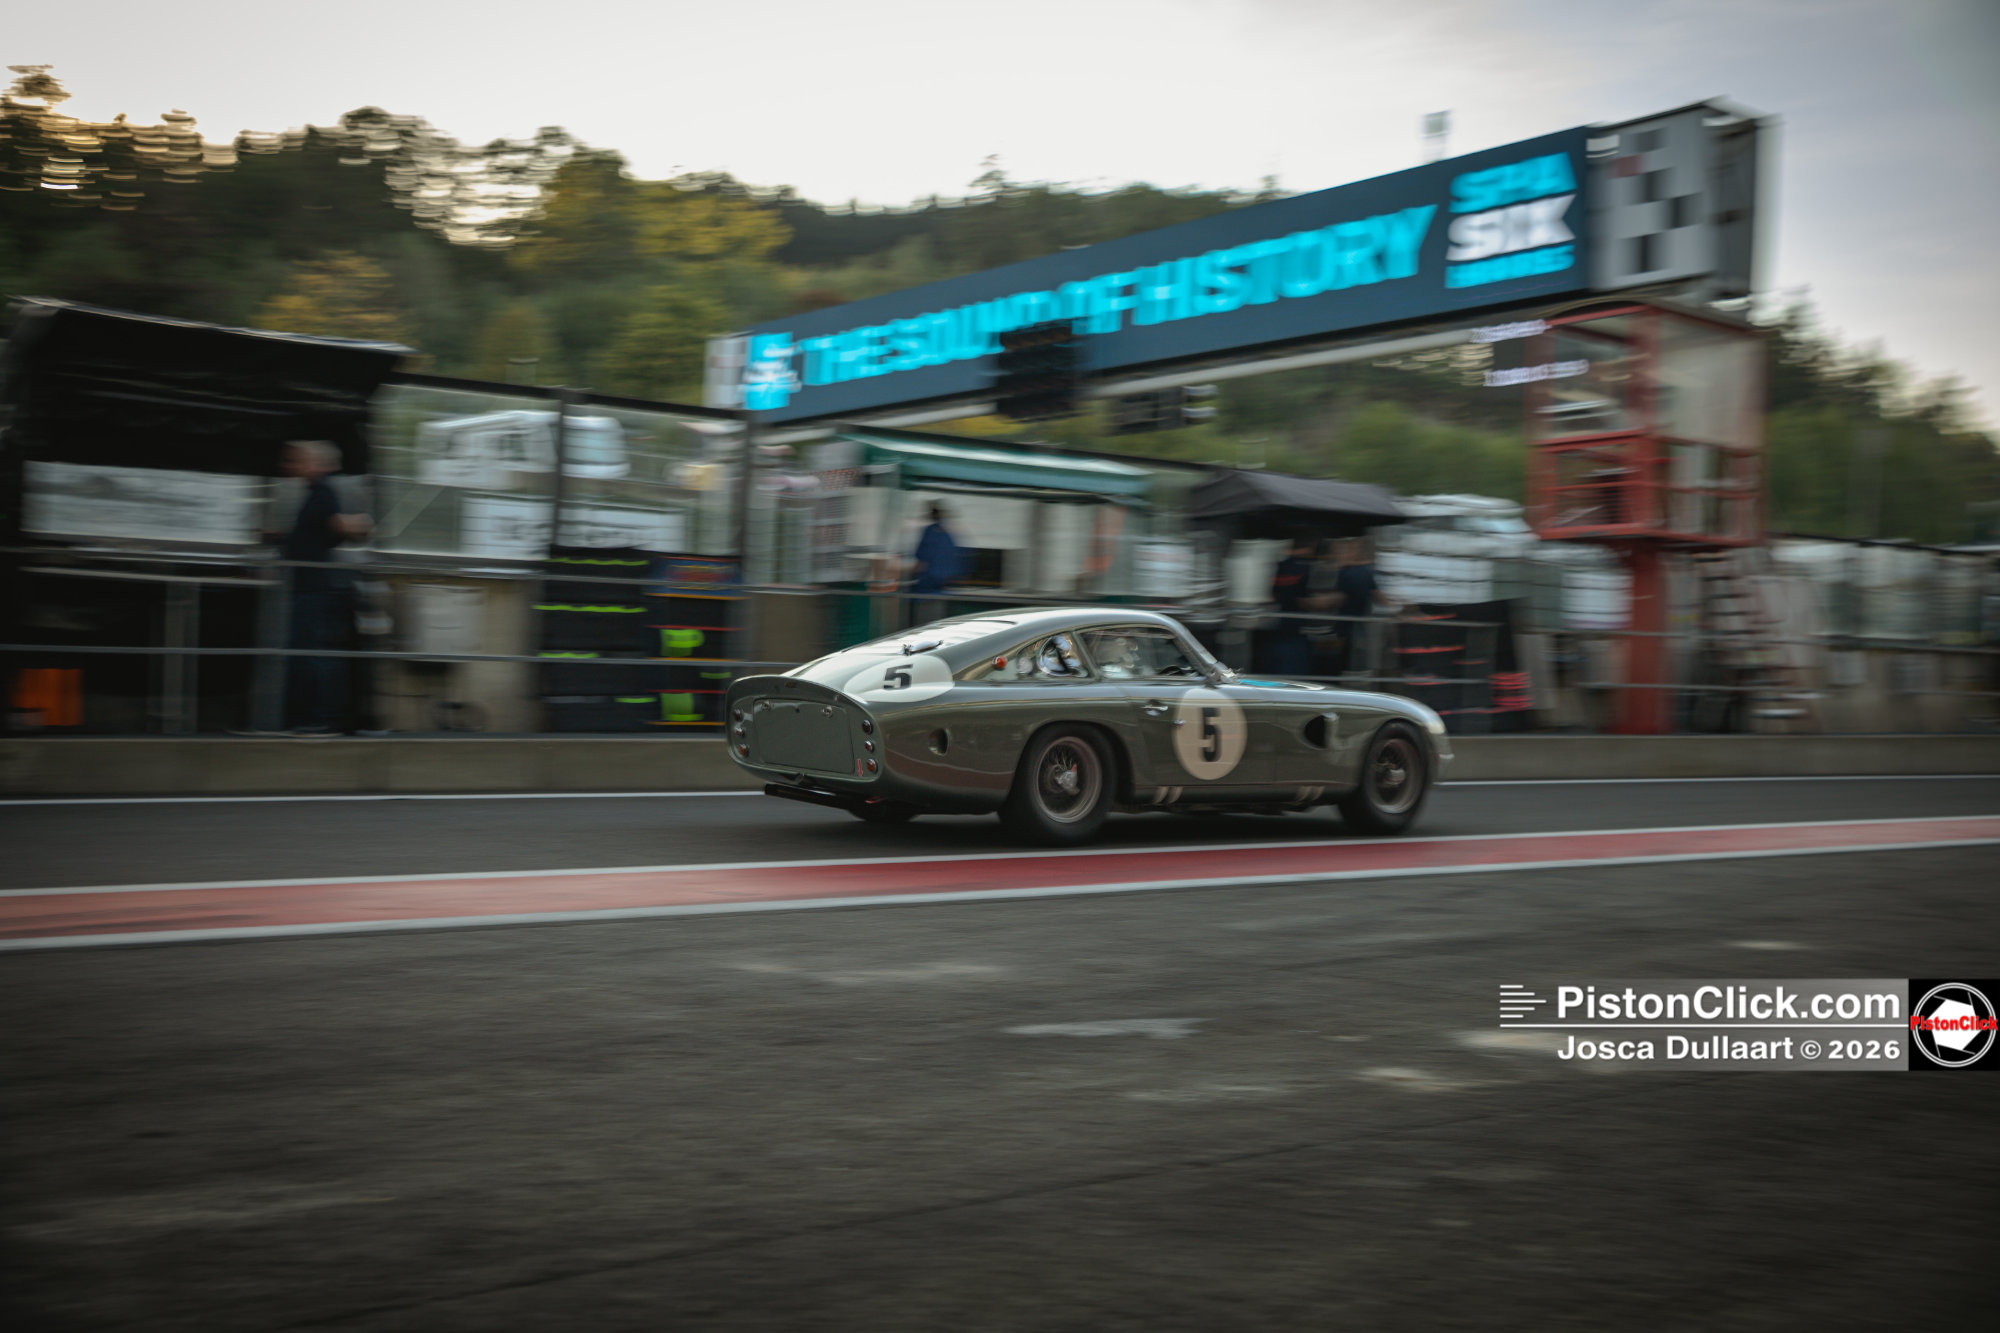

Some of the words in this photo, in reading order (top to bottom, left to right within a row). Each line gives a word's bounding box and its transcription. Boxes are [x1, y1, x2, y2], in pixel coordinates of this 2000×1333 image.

[1445, 193, 1577, 261] SIX
[1131, 204, 1438, 325] HISTORY
[883, 663, 913, 690] 5
[1199, 707, 1222, 762] 5
